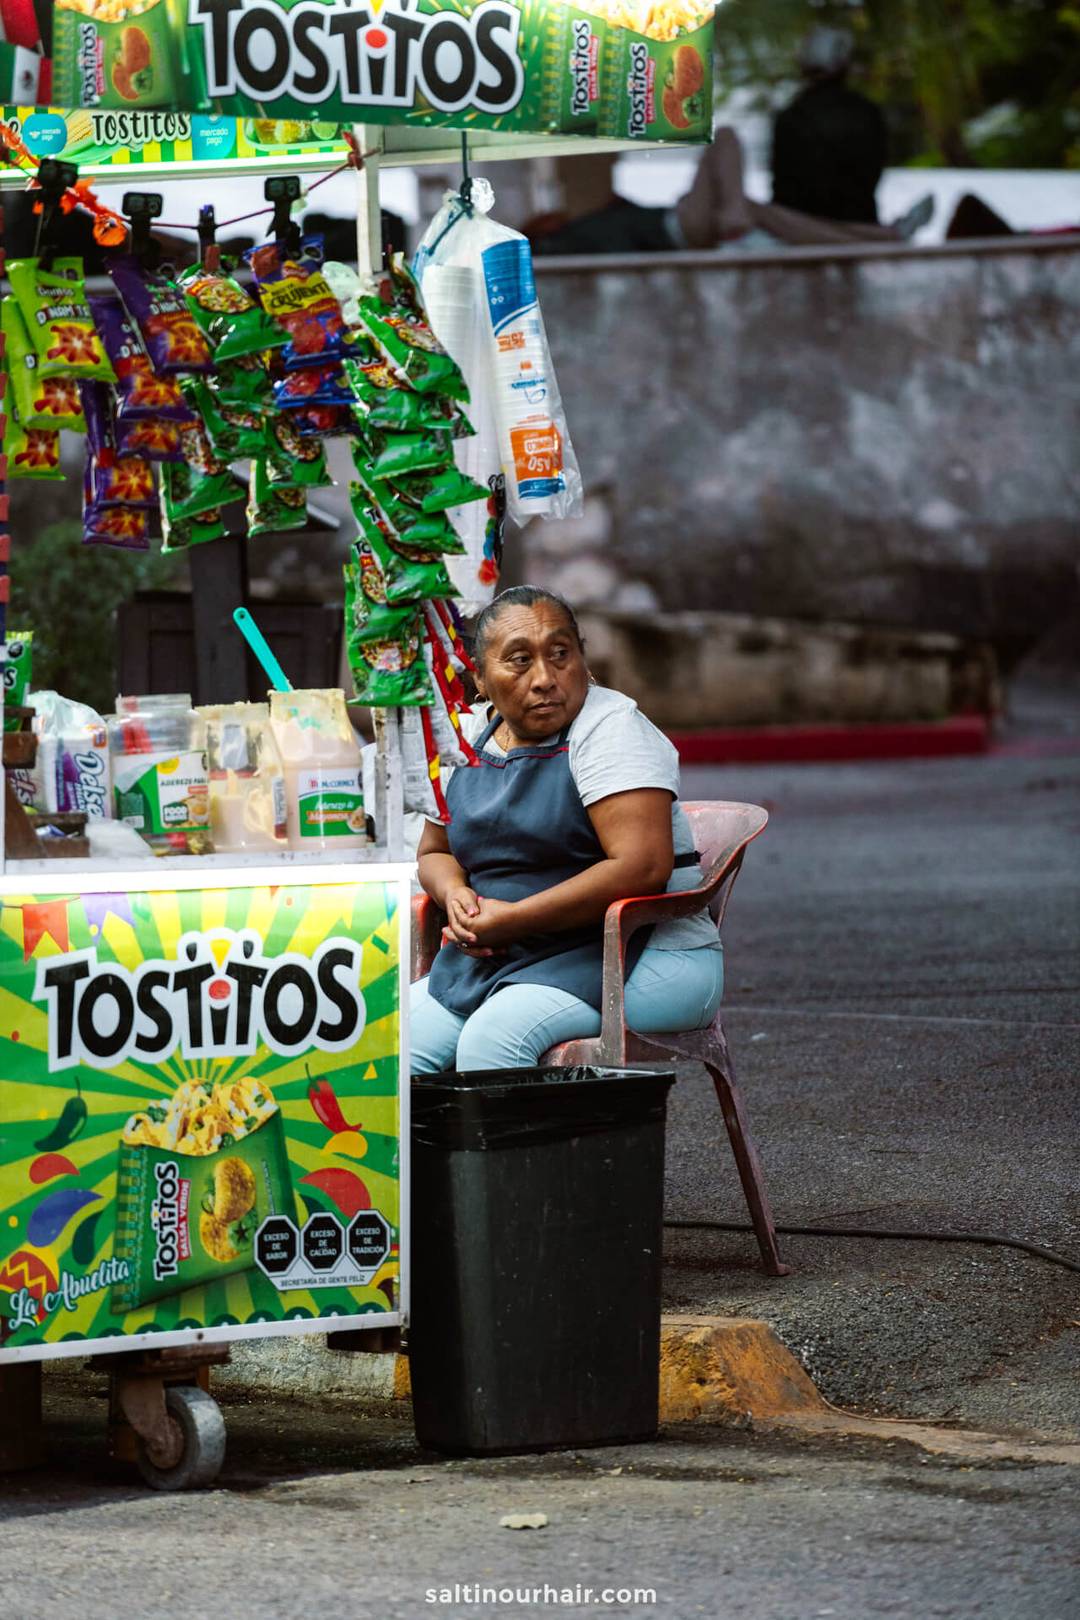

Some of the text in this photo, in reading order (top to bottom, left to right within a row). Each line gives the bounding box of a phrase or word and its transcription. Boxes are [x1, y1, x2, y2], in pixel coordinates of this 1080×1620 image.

[198, 0, 518, 107] TOSTITOS
[571, 22, 589, 113] TOSTITOS
[629, 44, 647, 135] TOSTITOS
[74, 751, 107, 818] Delse
[44, 940, 359, 1060] TOSTITOS
[153, 1163, 177, 1278] TOSTITOS
[178, 1181, 190, 1218] VERDE
[355, 1227, 381, 1236] EXCESO
[179, 1220, 190, 1258] SALSA
[263, 1232, 290, 1241] EXCESO
[310, 1229, 336, 1239] EXCESO
[318, 1239, 327, 1247] DE
[9, 1256, 129, 1330] La Abuelita
